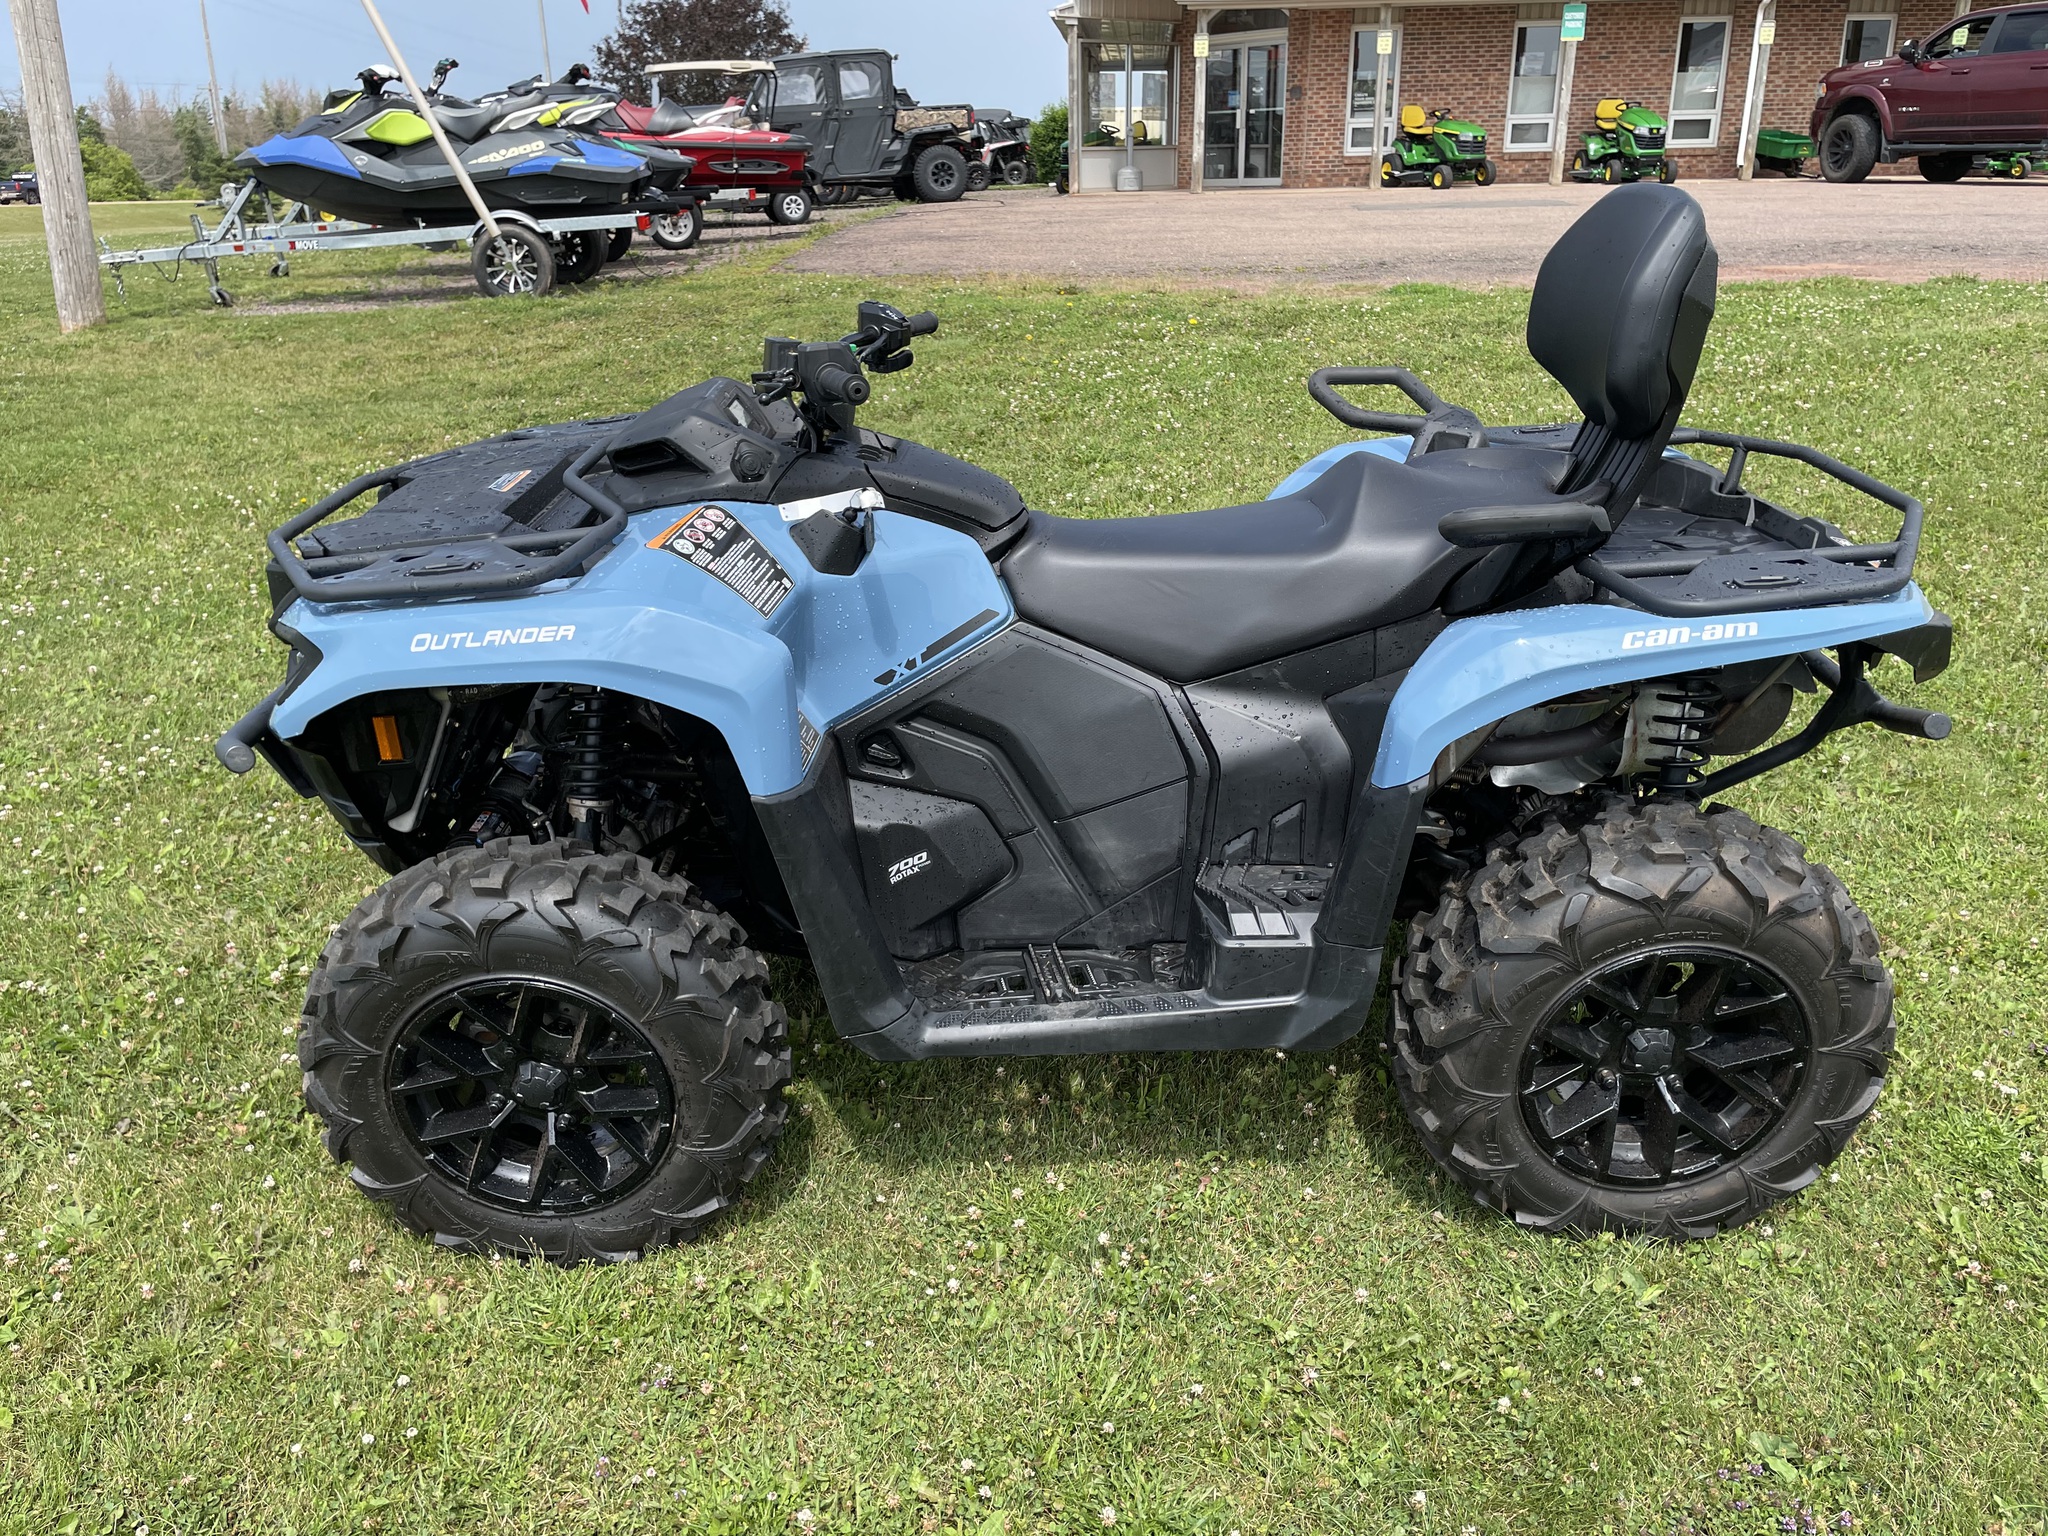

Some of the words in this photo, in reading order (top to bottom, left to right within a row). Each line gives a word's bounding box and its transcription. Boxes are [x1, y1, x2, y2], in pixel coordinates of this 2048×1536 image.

[295, 240, 319, 250] MOVE
[410, 625, 576, 653] OUTLANDER
[887, 851, 928, 878] 700
[889, 866, 921, 885] ROTAX
